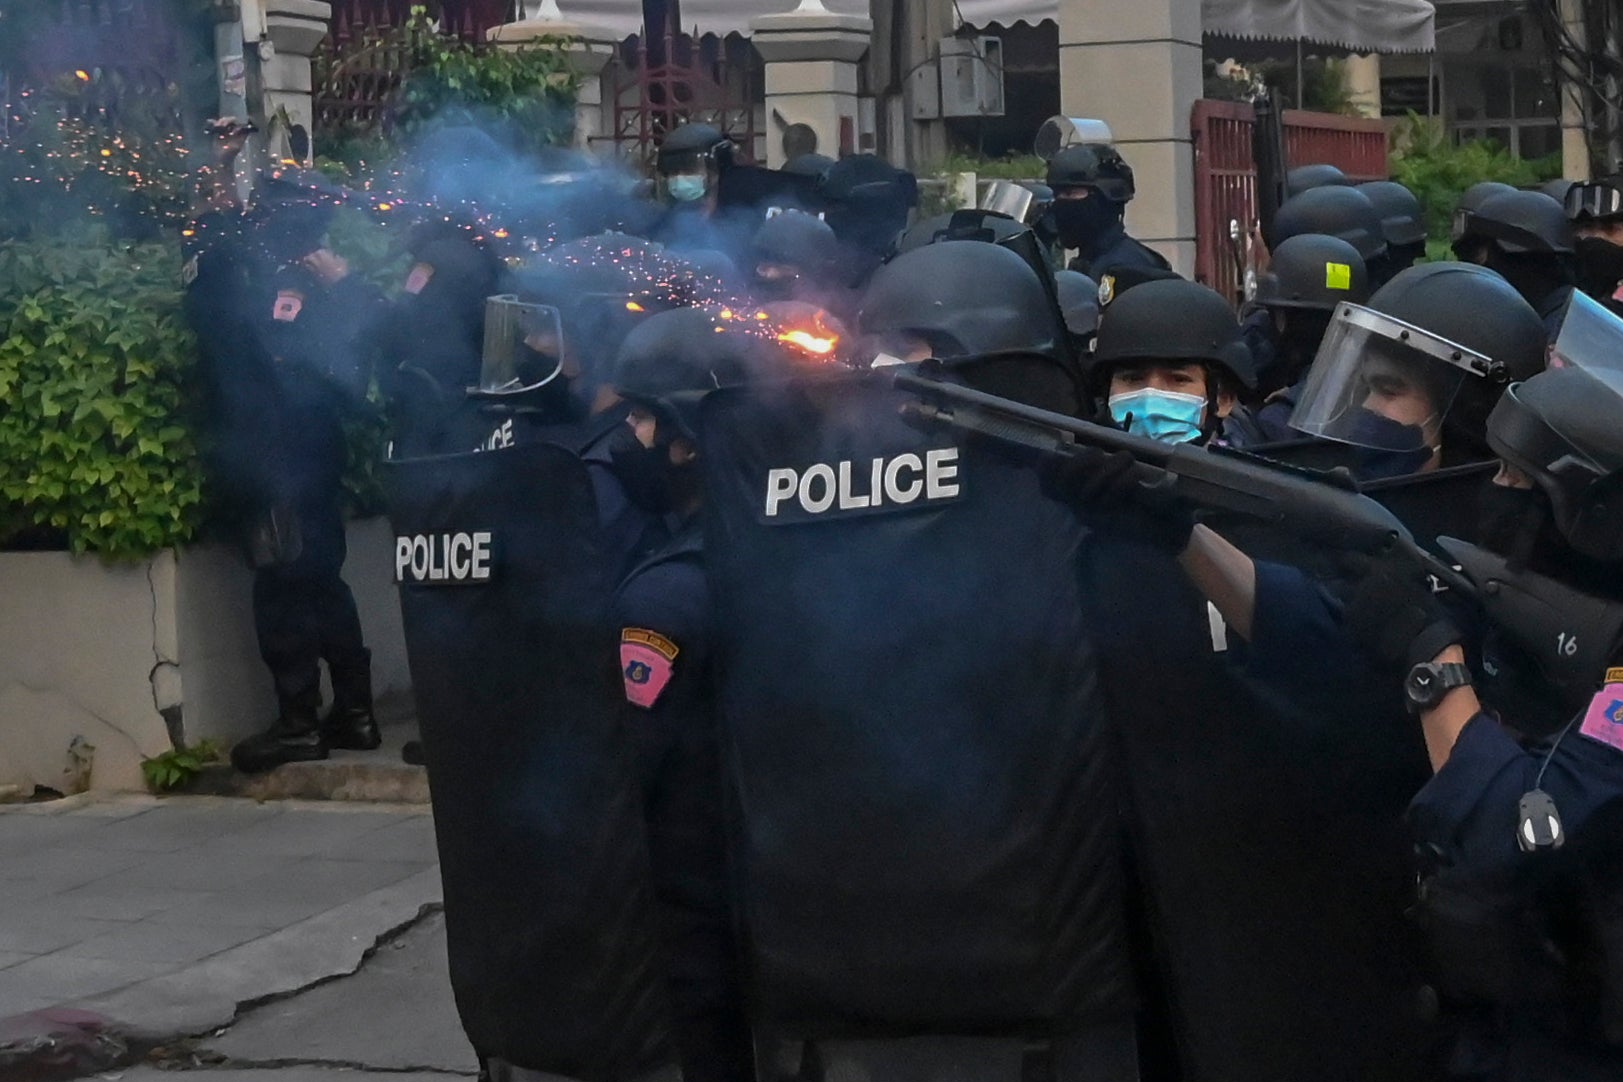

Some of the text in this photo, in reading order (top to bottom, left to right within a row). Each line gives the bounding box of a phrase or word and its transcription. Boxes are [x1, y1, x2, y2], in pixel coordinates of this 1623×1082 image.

[766, 448, 960, 516] POLICE
[396, 532, 492, 581] POLICE
[1557, 632, 1578, 656] 16
